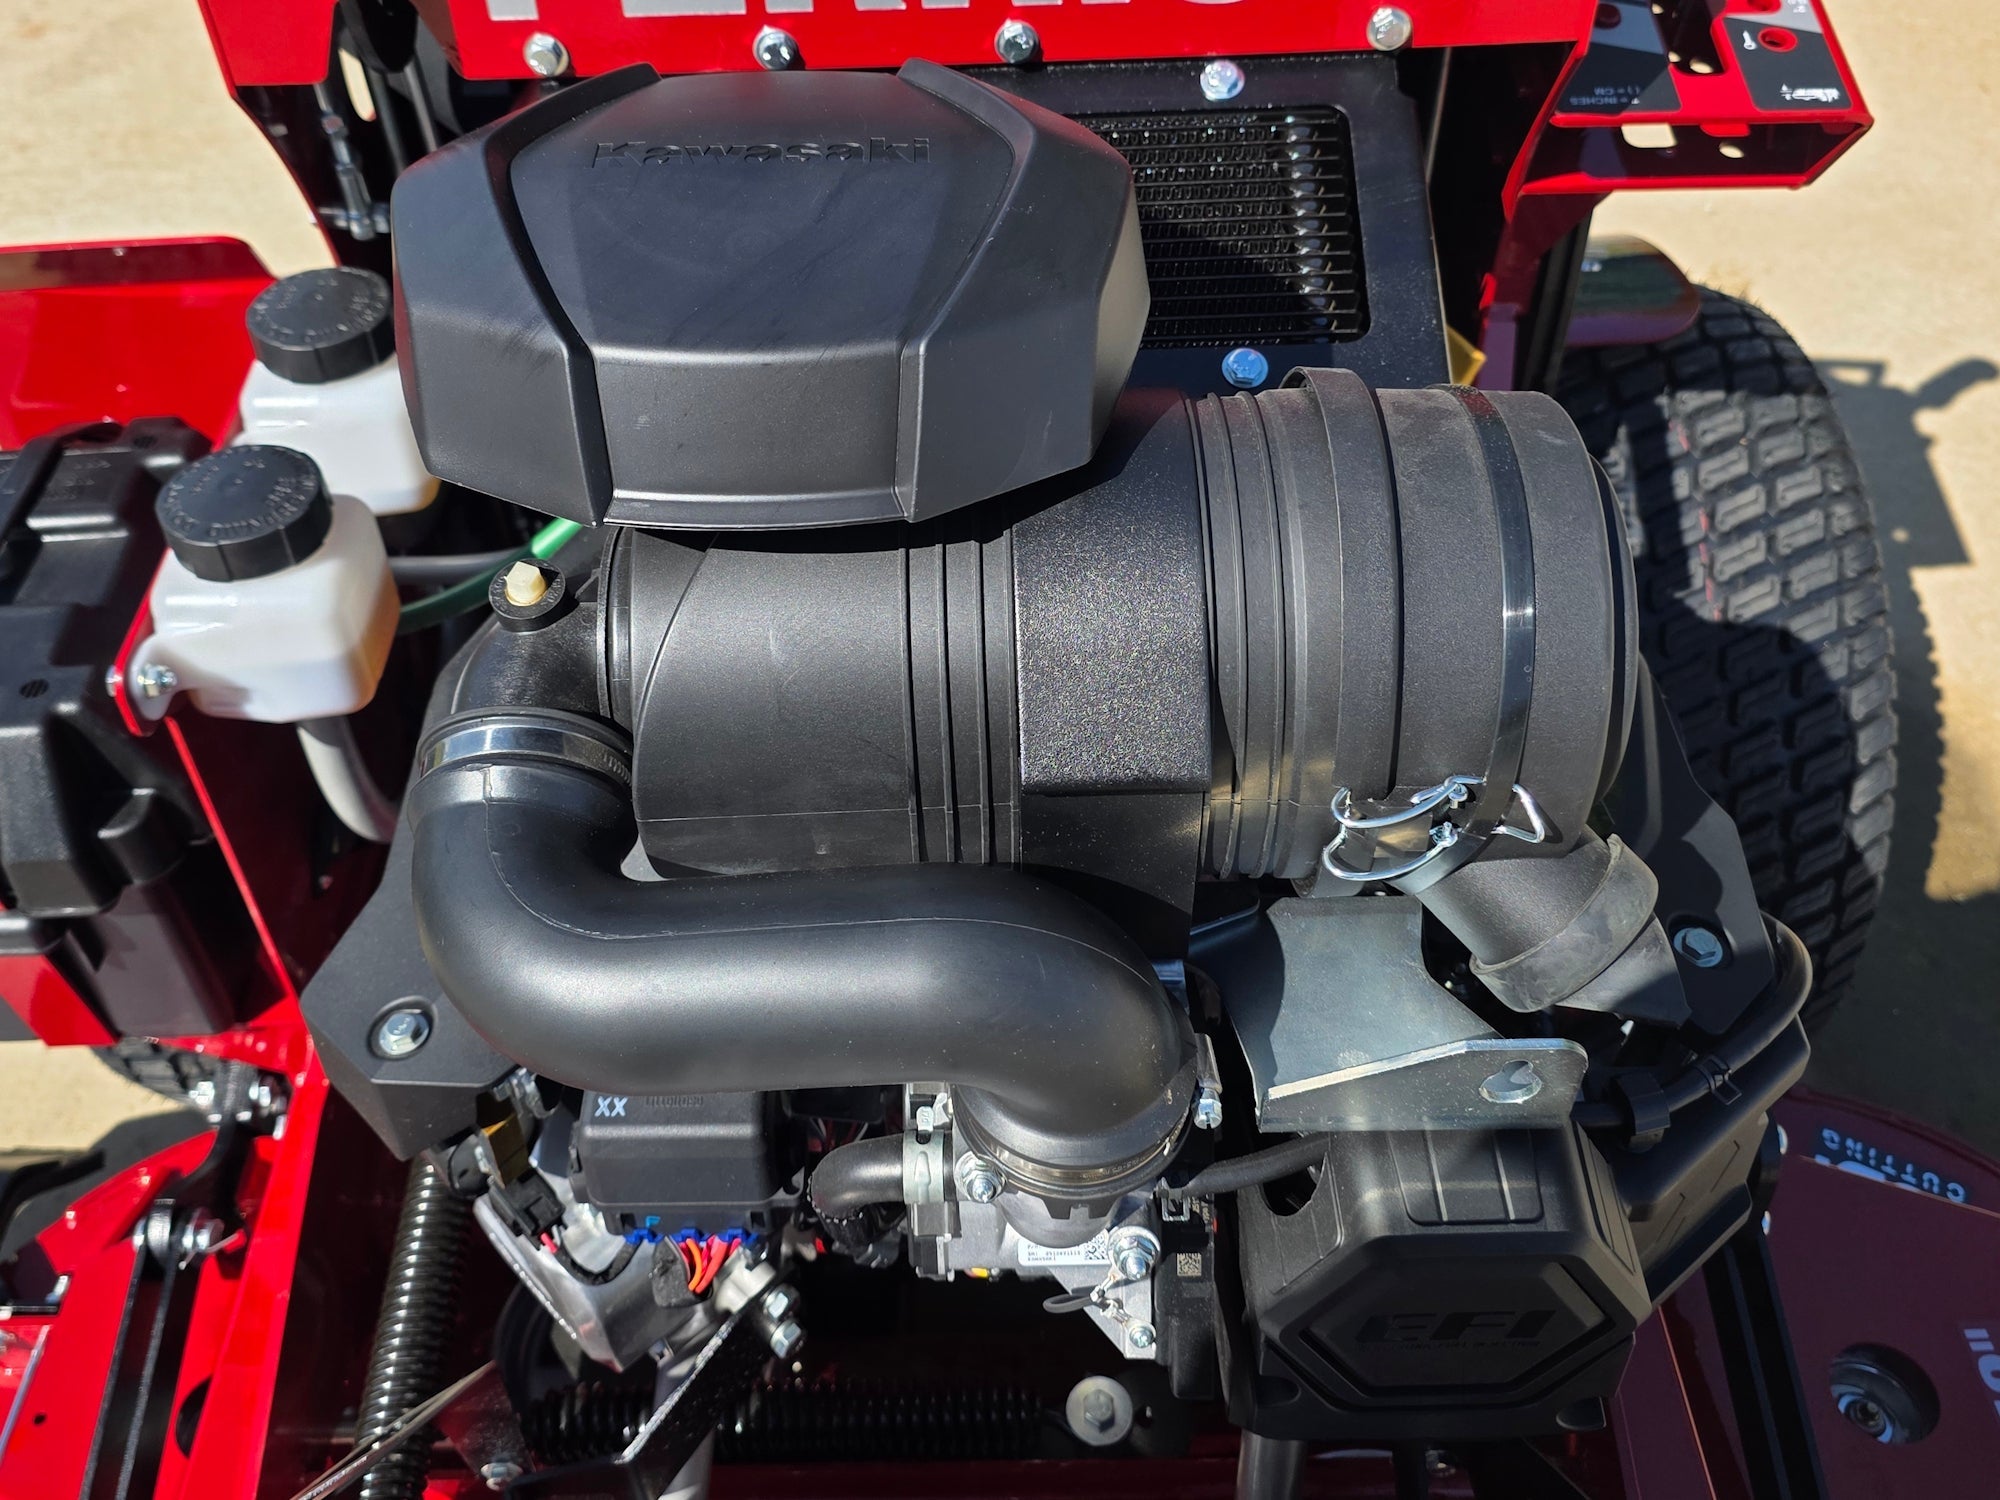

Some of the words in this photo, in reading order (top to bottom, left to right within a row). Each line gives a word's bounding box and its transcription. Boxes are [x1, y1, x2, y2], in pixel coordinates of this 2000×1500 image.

[1569, 95, 1618, 106] INCHES
[591, 136, 931, 169] Kawasaki
[594, 1095, 629, 1118] XX
[1821, 1127, 1966, 1204] CUTTING
[1354, 1310, 1556, 1343] EFI
